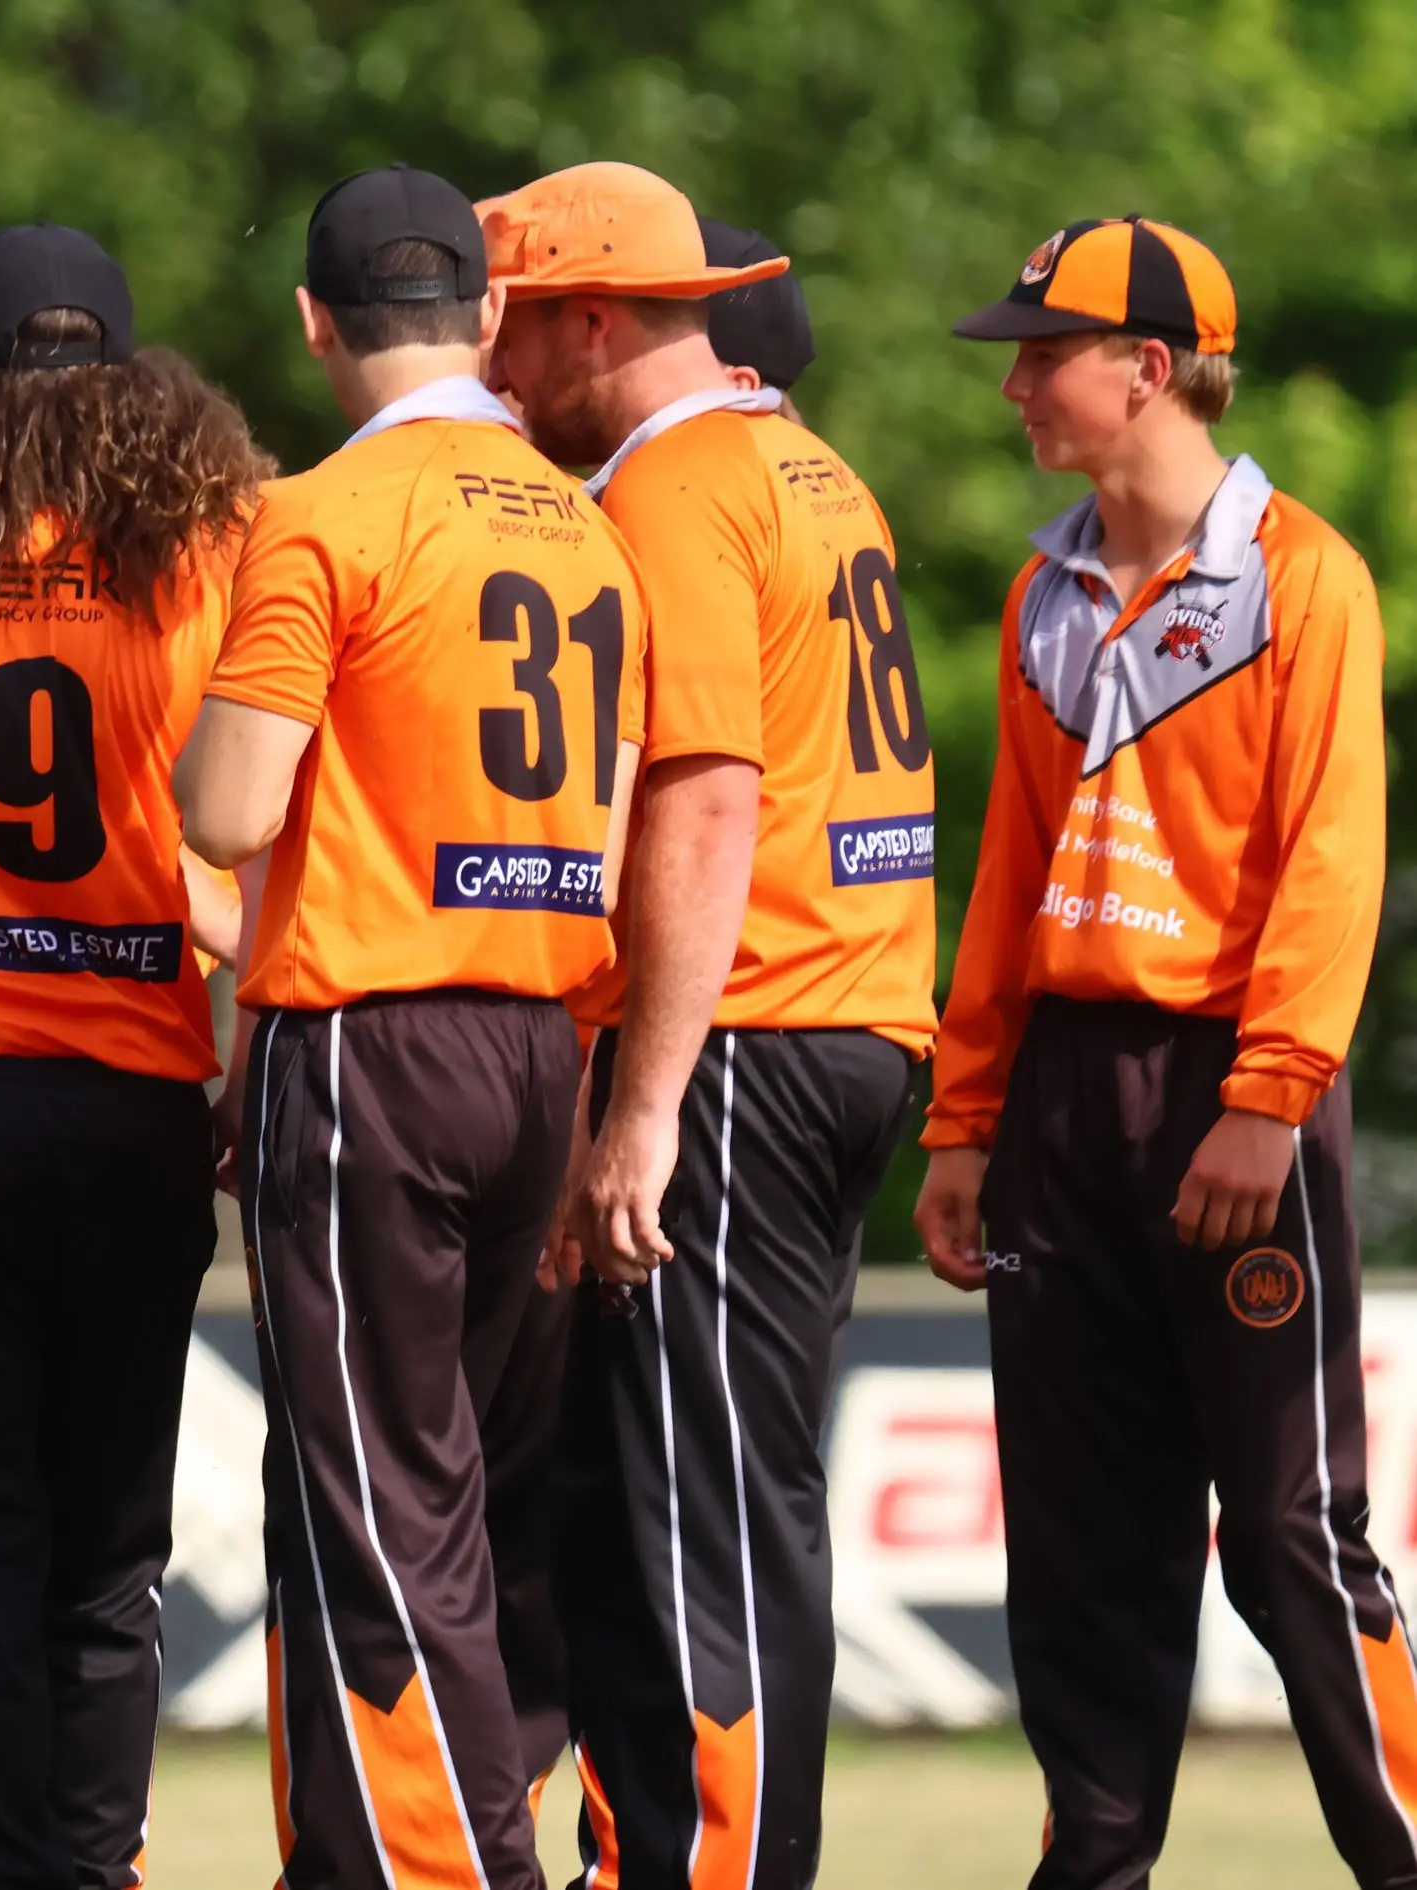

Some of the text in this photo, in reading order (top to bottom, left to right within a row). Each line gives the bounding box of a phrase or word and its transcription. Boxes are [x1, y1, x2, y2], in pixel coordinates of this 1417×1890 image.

[42, 605, 104, 624] GROUP
[828, 547, 933, 774] 18
[479, 569, 625, 806] 31
[1107, 796, 1157, 832] Bank
[839, 828, 911, 875] GAPSTED
[455, 855, 552, 897] GAPSTED
[1100, 891, 1186, 939] Bank
[70, 931, 164, 973] ESTATE
